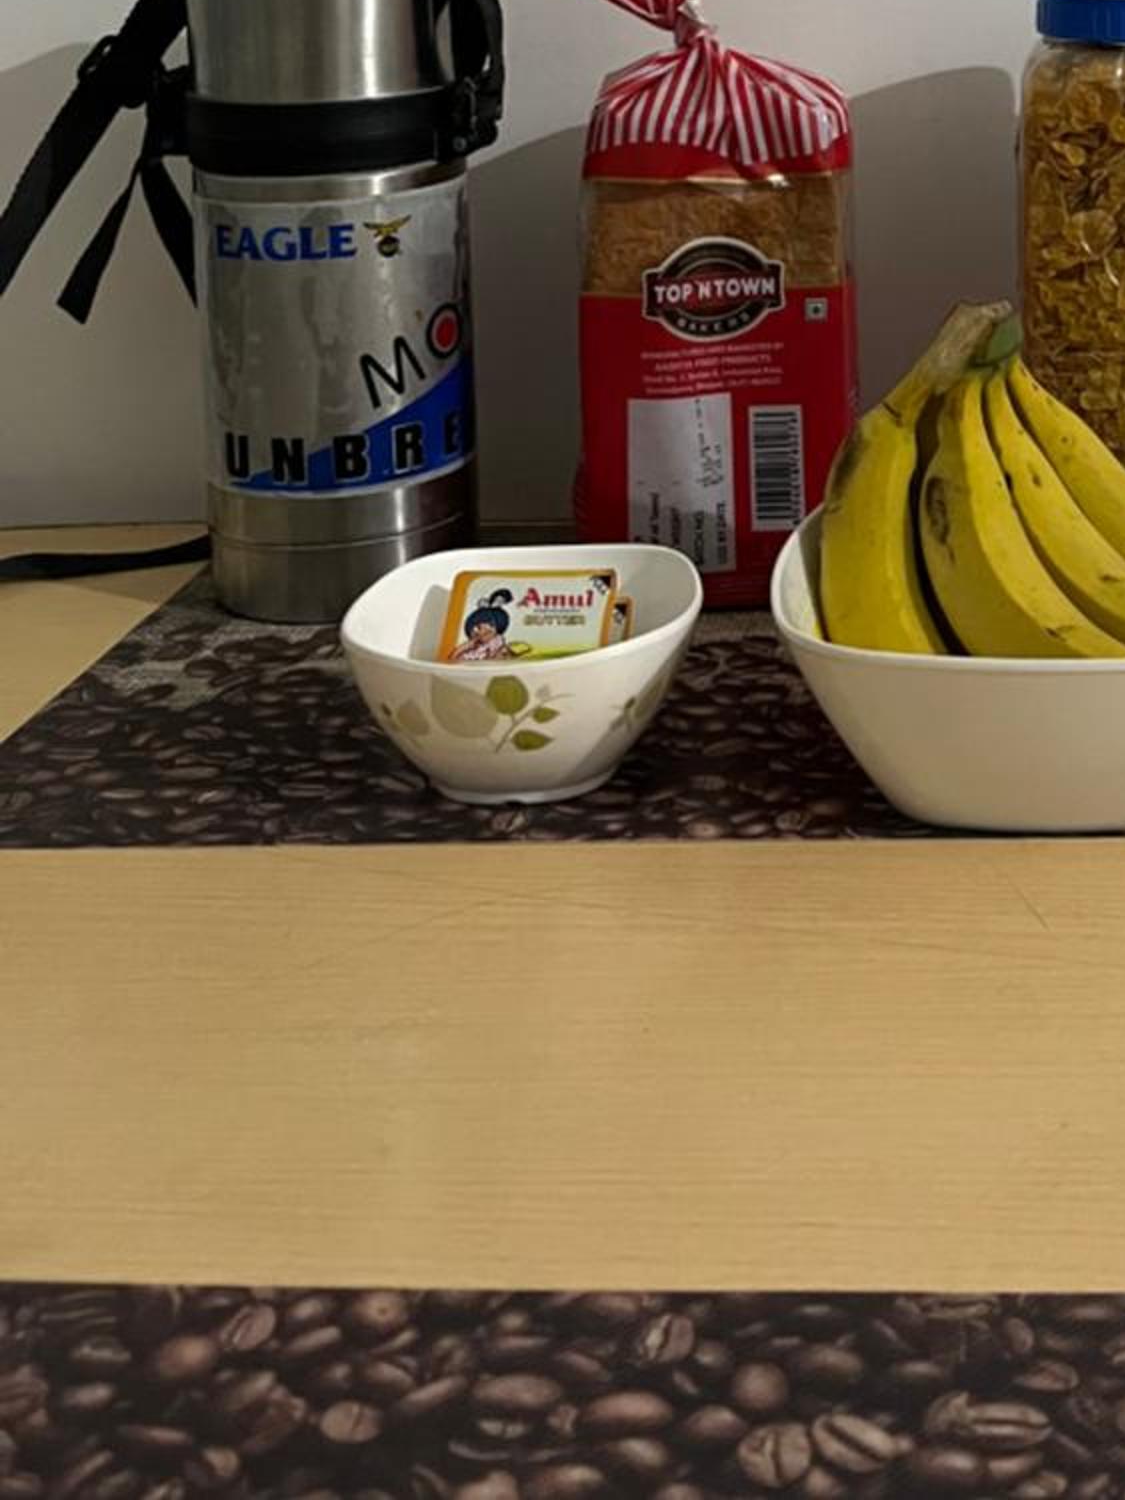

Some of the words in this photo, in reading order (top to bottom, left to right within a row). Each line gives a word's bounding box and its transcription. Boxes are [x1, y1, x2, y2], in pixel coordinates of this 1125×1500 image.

[215, 223, 358, 262] EAGLE
[653, 283, 693, 304] TOP
[714, 276, 776, 297] TOWN
[517, 587, 594, 608] Amul
